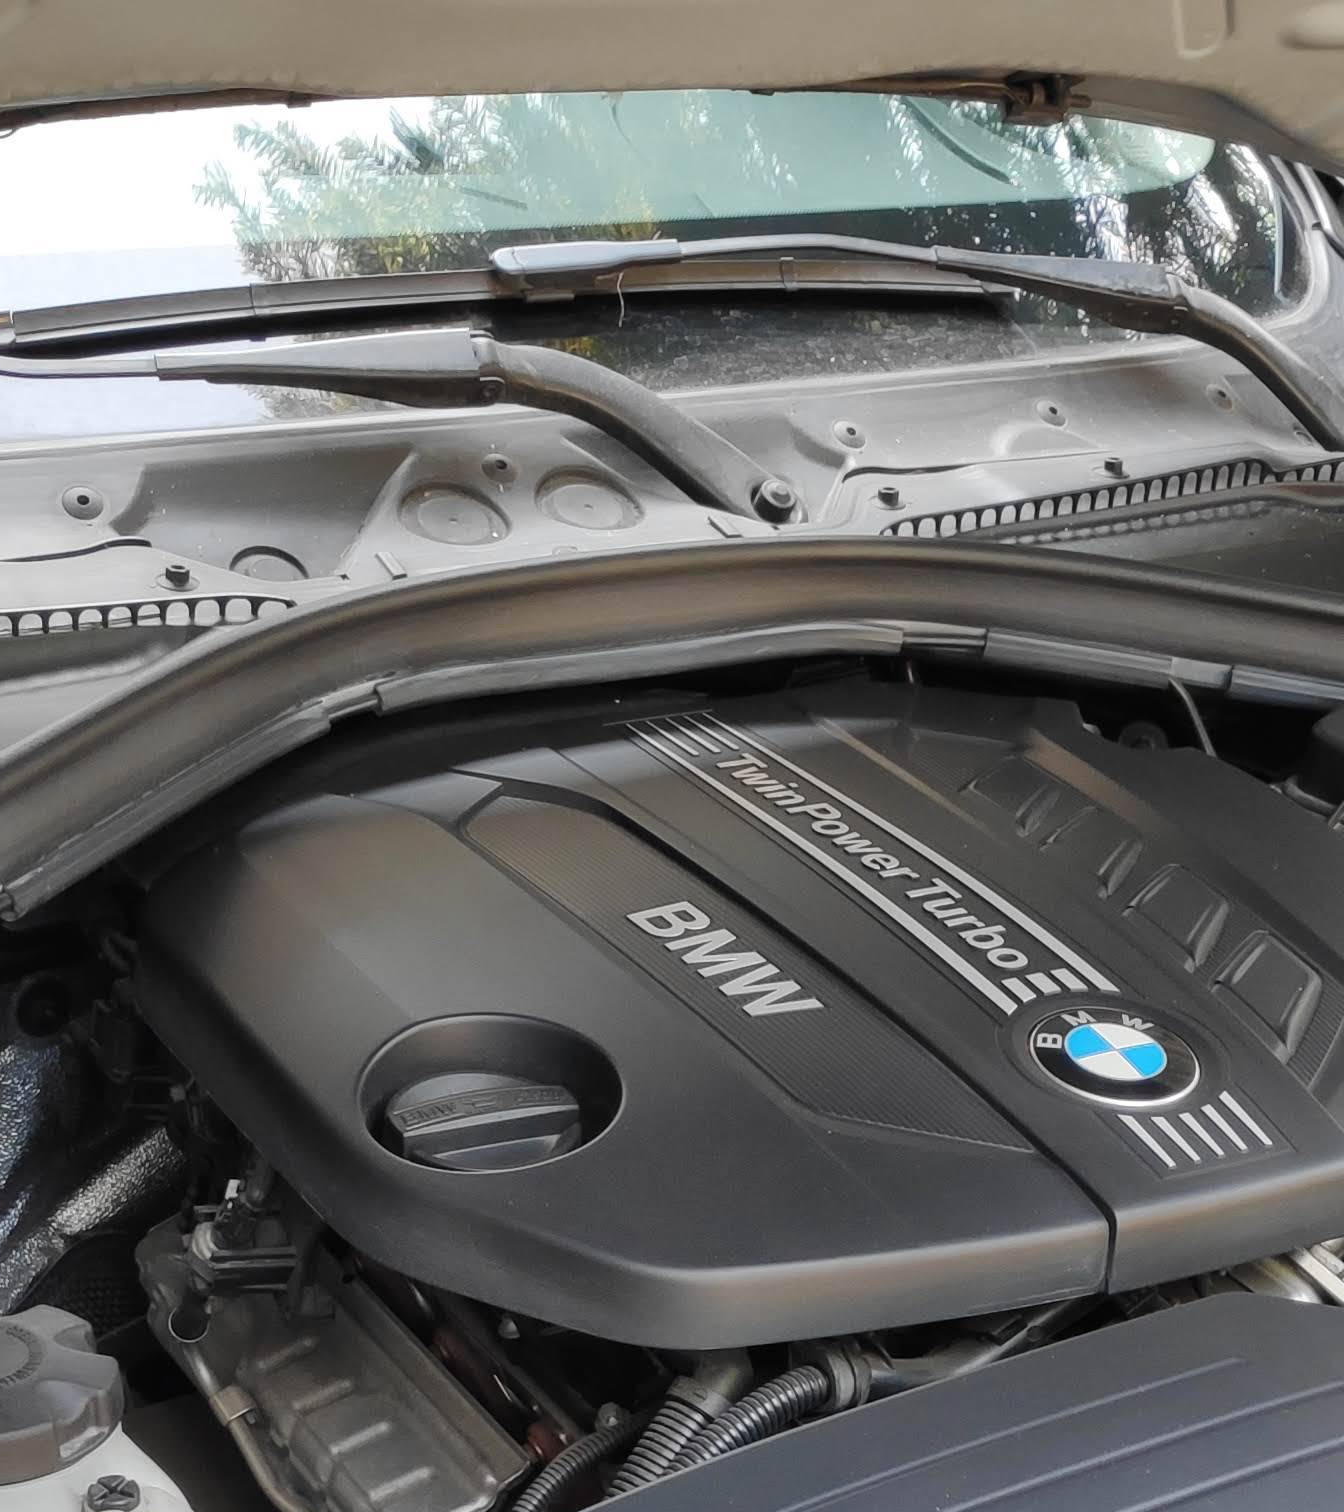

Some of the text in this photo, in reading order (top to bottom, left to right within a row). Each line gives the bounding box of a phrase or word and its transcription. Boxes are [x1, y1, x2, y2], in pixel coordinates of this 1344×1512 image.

[714, 752, 1028, 972] TwinPower Turbo
[627, 901, 825, 1017] BMW
[1036, 1009, 1153, 1050] BMW
